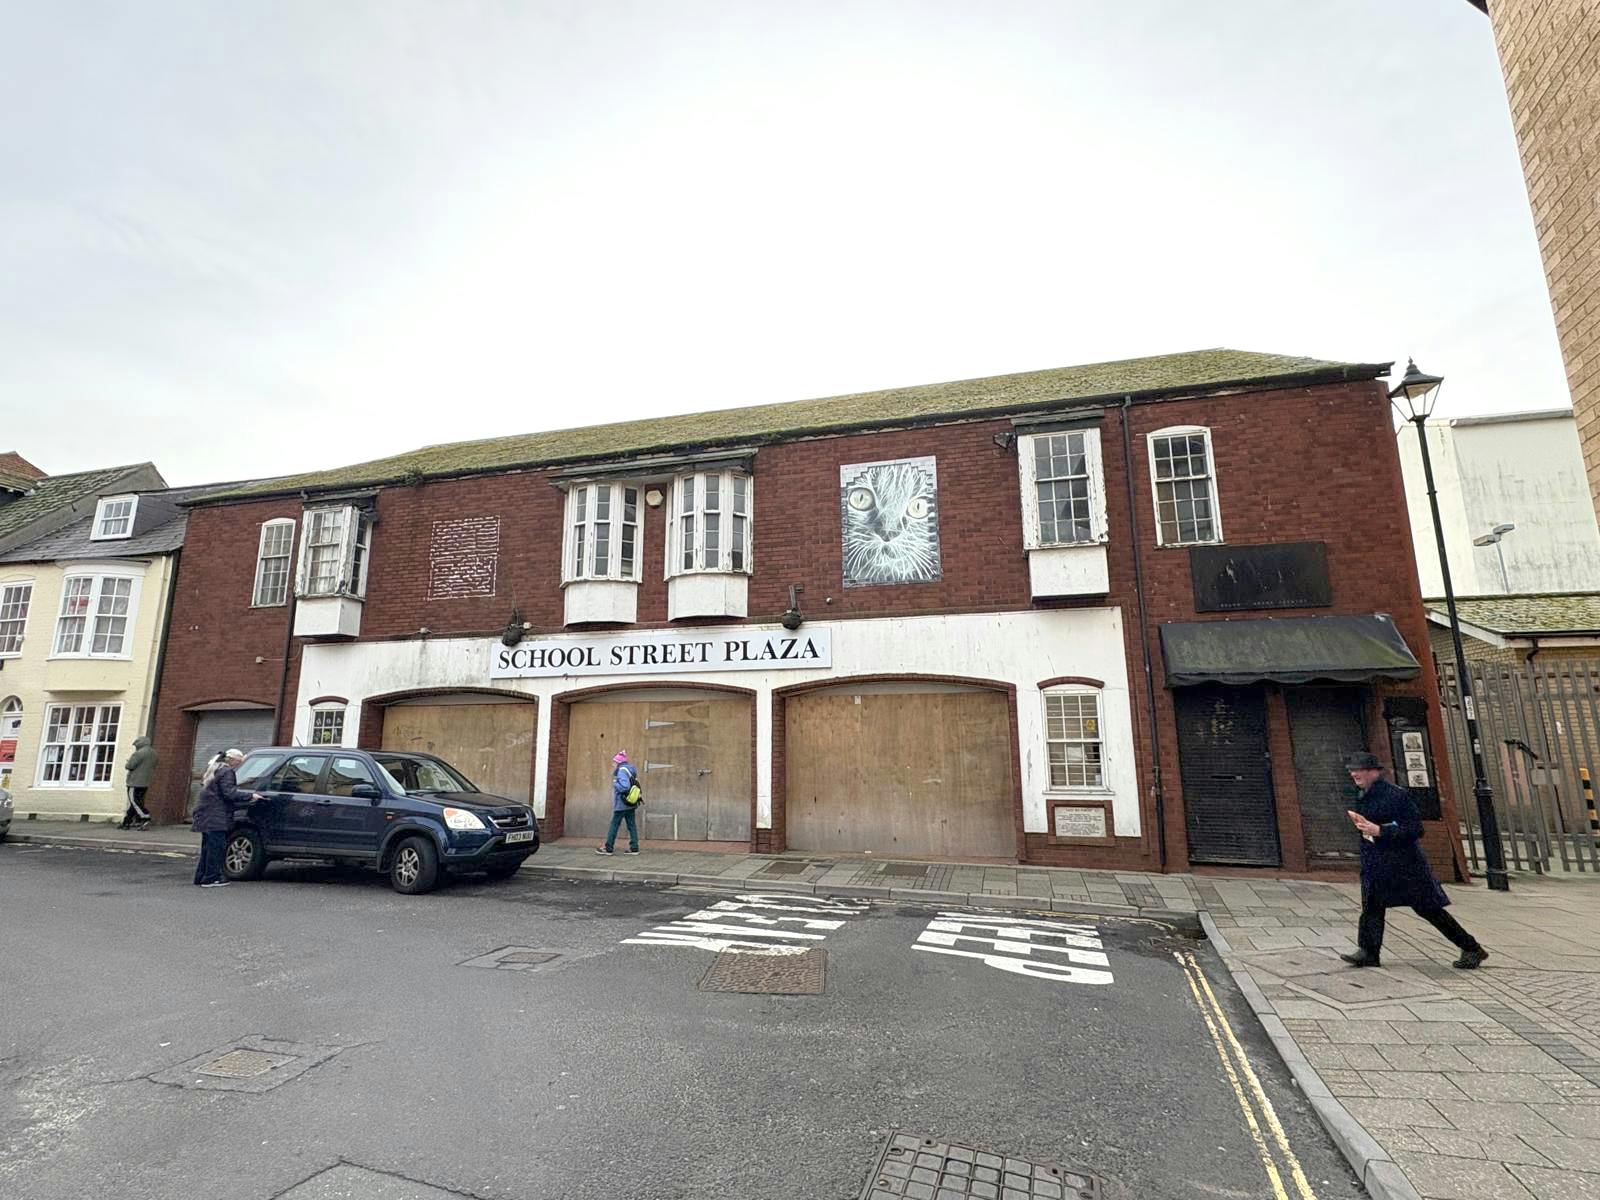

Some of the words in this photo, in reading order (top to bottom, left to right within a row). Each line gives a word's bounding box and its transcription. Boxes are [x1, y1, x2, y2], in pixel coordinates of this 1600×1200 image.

[498, 646, 600, 670] SCHOOL
[610, 641, 713, 666] STREET
[723, 637, 820, 661] PLAZA
[910, 911, 1114, 985] KEEP
